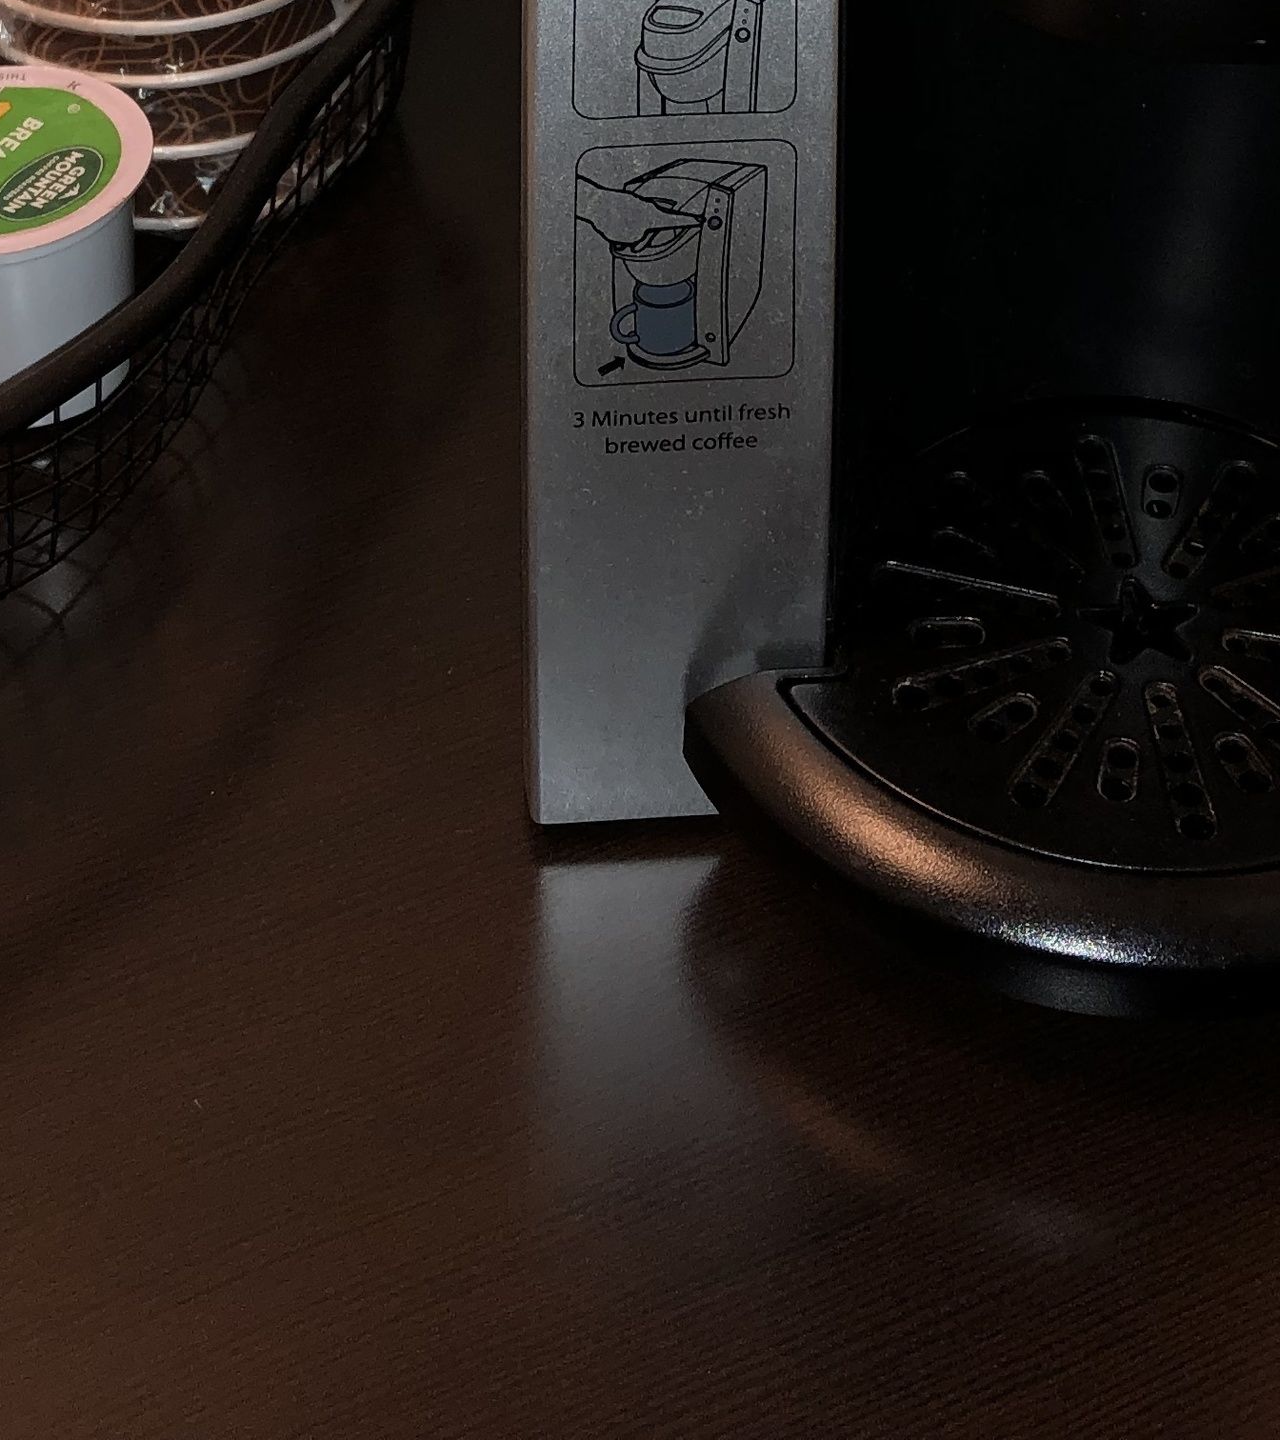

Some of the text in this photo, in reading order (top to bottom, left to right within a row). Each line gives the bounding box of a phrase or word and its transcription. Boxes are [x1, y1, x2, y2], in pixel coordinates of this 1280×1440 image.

[2, 151, 85, 213] MOUNTAIN
[30, 165, 86, 209] GREEN
[573, 403, 791, 428] 3 Minutes until fresh
[605, 431, 759, 454] brewed coffee
